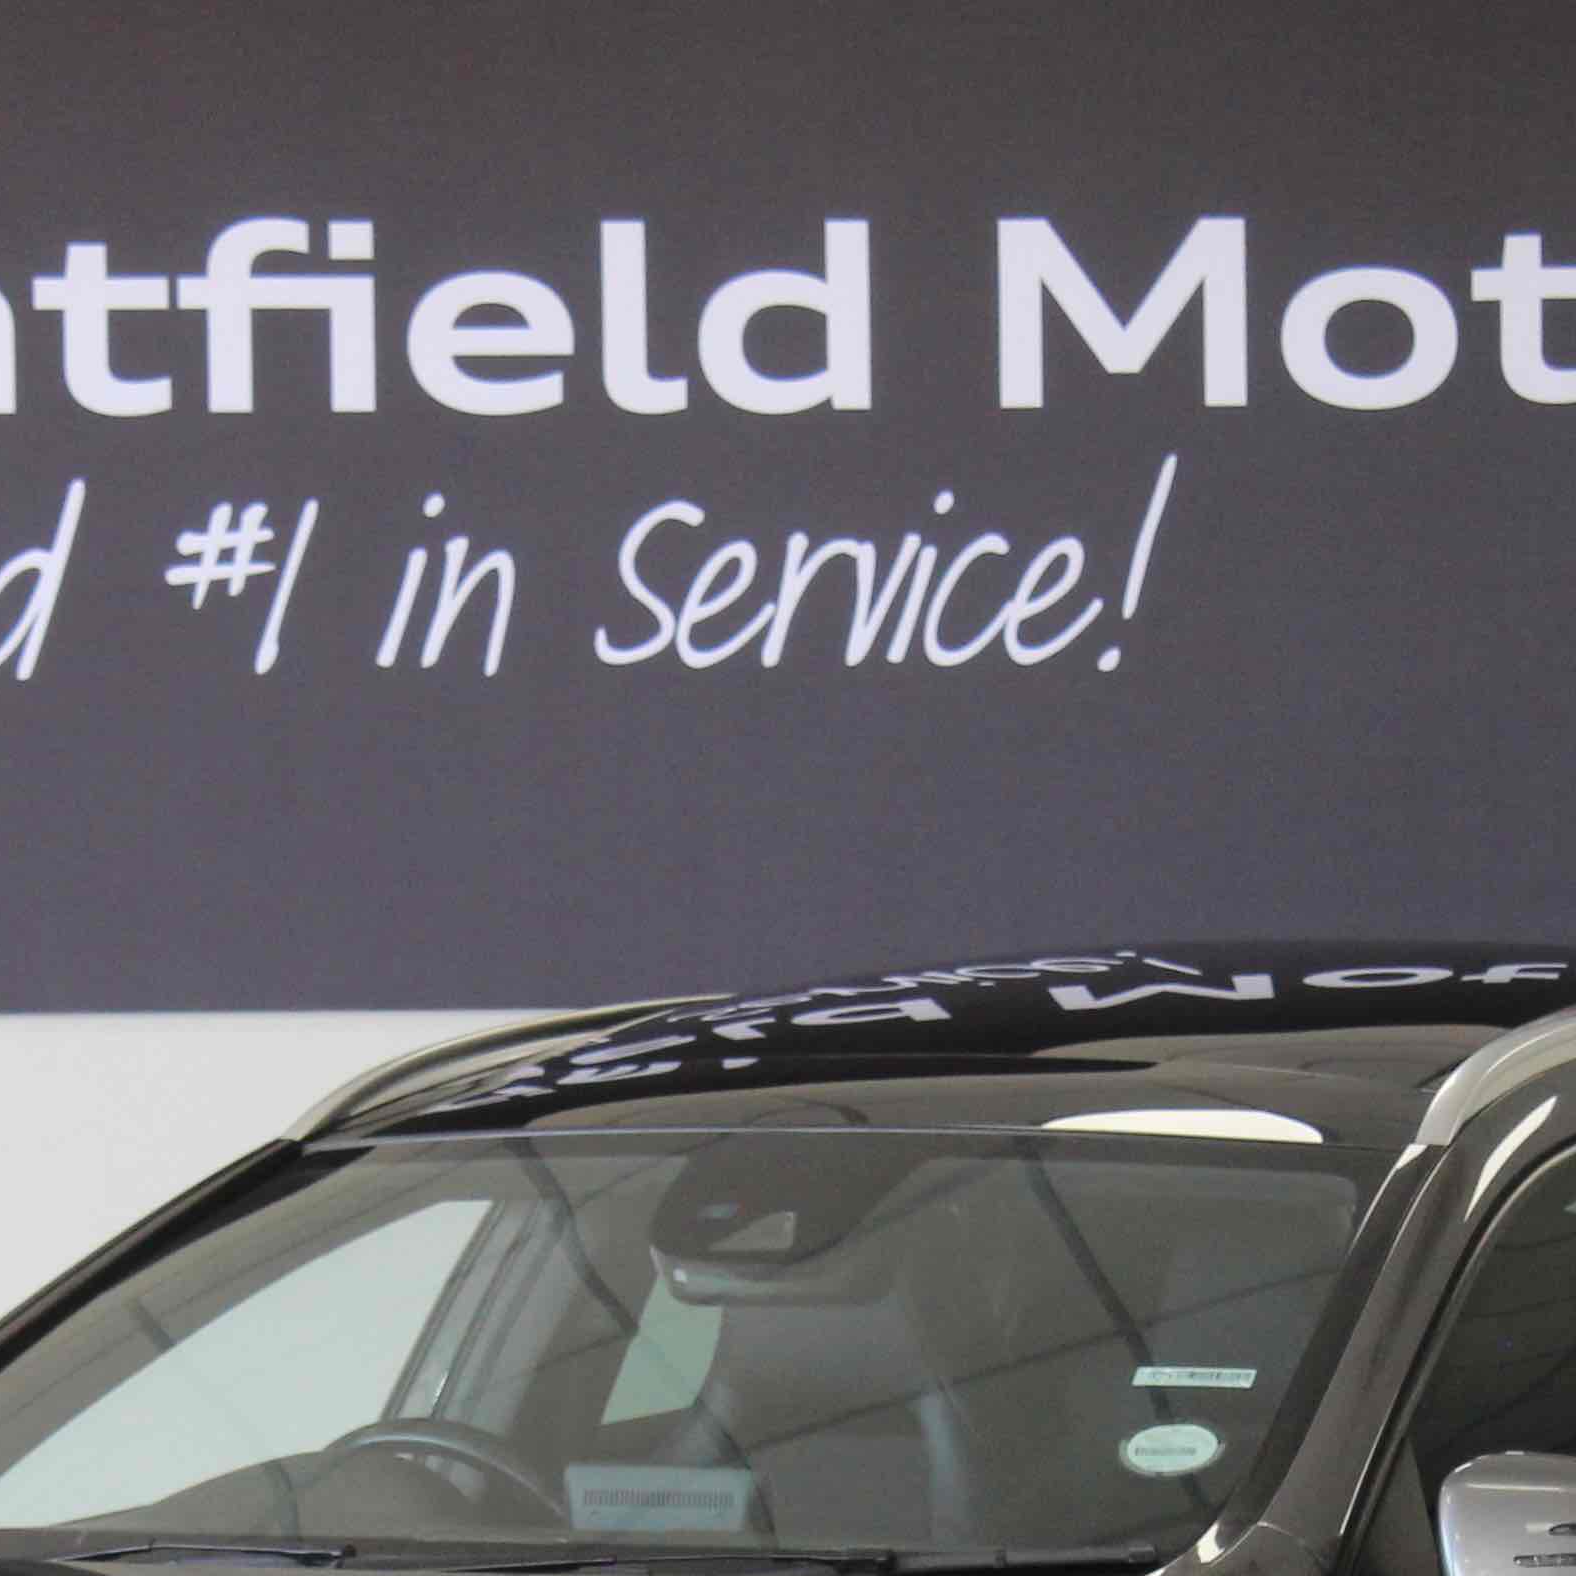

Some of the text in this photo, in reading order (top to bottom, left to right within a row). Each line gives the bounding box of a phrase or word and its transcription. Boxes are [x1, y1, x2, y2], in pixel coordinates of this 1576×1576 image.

[163, 498, 320, 676] #1
[375, 492, 517, 678] in
[593, 453, 1179, 673] Service!
